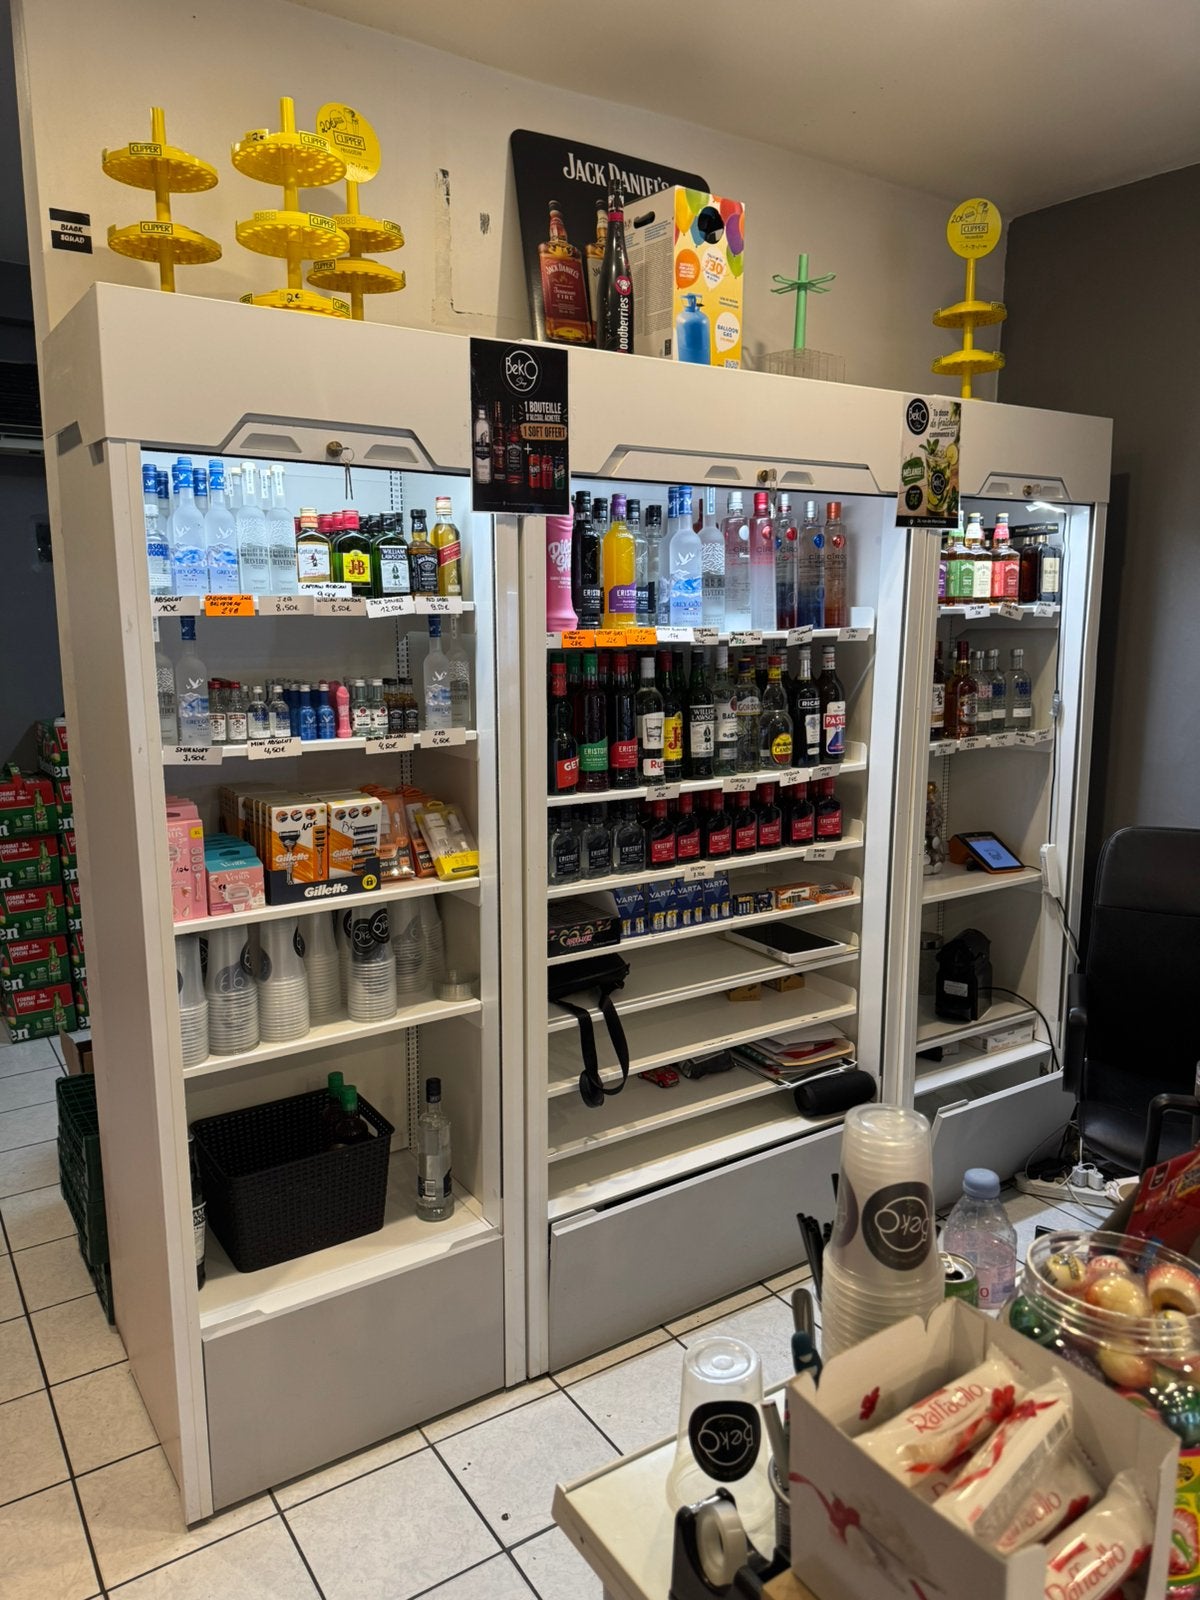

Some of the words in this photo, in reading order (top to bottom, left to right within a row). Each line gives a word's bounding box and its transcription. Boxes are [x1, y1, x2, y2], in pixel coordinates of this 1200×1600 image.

[302, 134, 328, 148] CLIPPER
[336, 132, 364, 149] CLIPPER
[131, 143, 160, 154] CLIPPER
[562, 152, 607, 188] JACK
[60, 223, 83, 234] BLACK
[142, 222, 171, 234] CLIPPER
[311, 215, 336, 231] CLIPPER
[60, 233, 86, 244] SQUAD
[556, 293, 574, 301] FIRE
[617, 295, 629, 352] oodberries
[717, 323, 739, 334] BALLOON
[529, 401, 562, 414] BOUTEILLE
[528, 425, 543, 438] SOFT
[544, 426, 566, 439] OFFERT
[349, 559, 366, 575] J&B
[267, 737, 293, 746] ABSOLUT
[275, 853, 309, 863] Gillette
[332, 848, 363, 859] Gillette
[225, 870, 251, 881] Venus
[677, 882, 702, 895] VARTA
[704, 879, 728, 889] VARTA
[304, 883, 349, 898] Gillette
[649, 888, 677, 899] VARTA
[616, 894, 644, 904] VARTA
[906, 1382, 985, 1434] Raffaello
[698, 1424, 754, 1453] BekO
